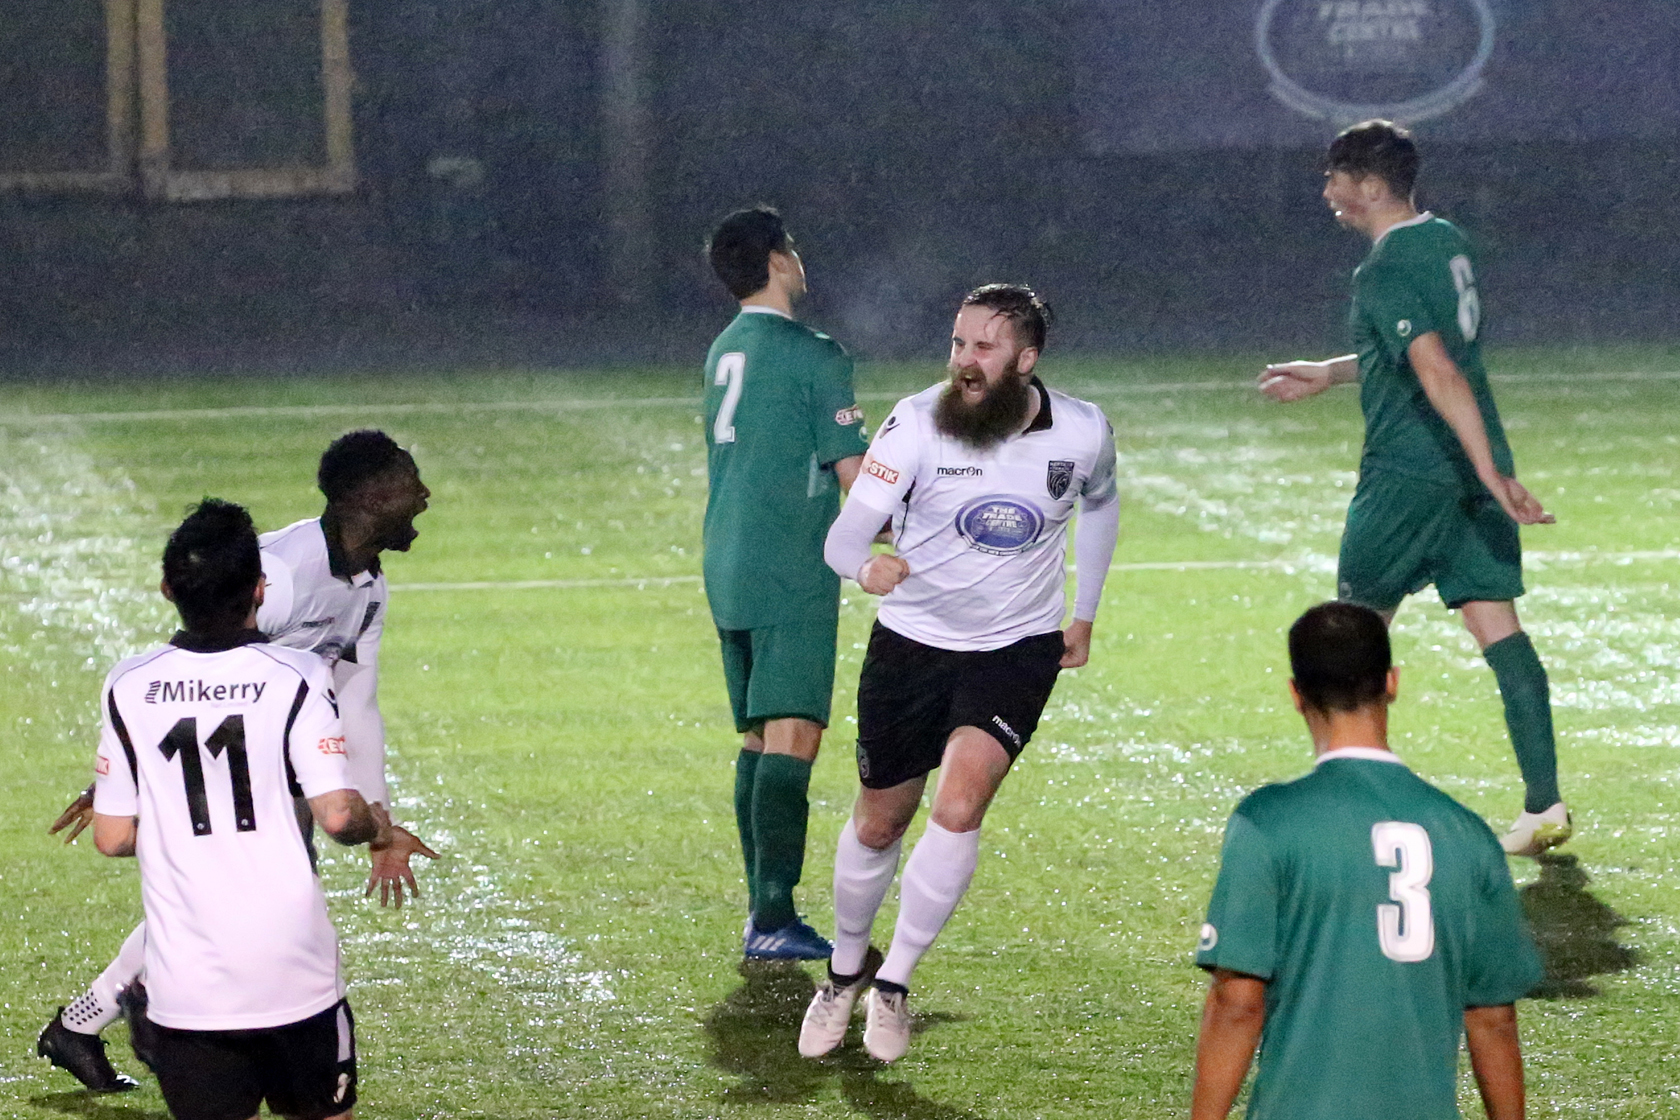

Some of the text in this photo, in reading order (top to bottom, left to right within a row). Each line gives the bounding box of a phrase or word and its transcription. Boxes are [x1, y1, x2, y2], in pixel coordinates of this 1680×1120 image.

[1449, 254, 1480, 342] 6
[714, 352, 746, 444] 2
[937, 466, 983, 477] macron
[162, 679, 267, 704] Mikerry
[157, 714, 257, 837] 11
[1371, 821, 1436, 963] 3
